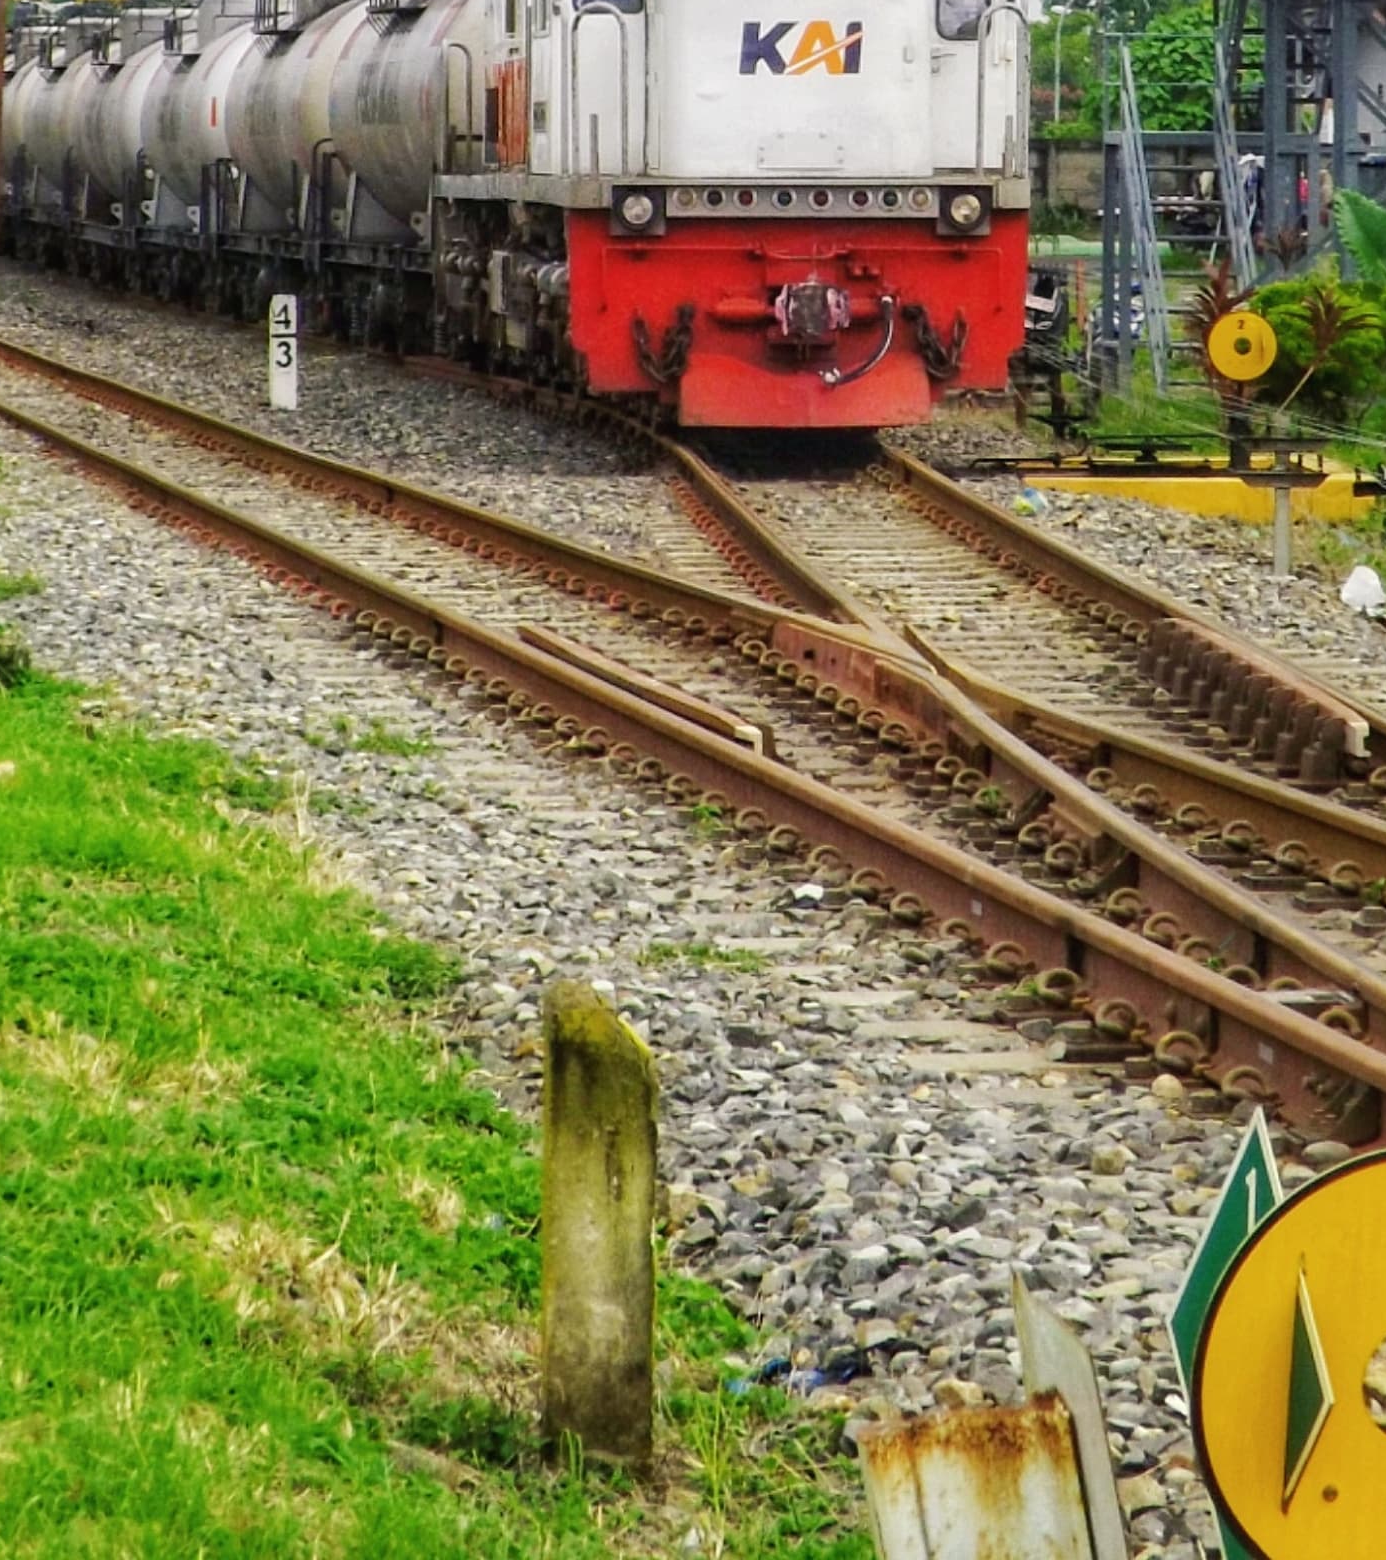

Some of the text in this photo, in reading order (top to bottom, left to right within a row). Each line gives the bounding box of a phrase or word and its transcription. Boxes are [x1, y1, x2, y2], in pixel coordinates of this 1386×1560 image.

[739, 20, 864, 75] KAI
[272, 303, 292, 330] 4
[276, 341, 293, 368] 3
[1244, 1167, 1257, 1237] 1
